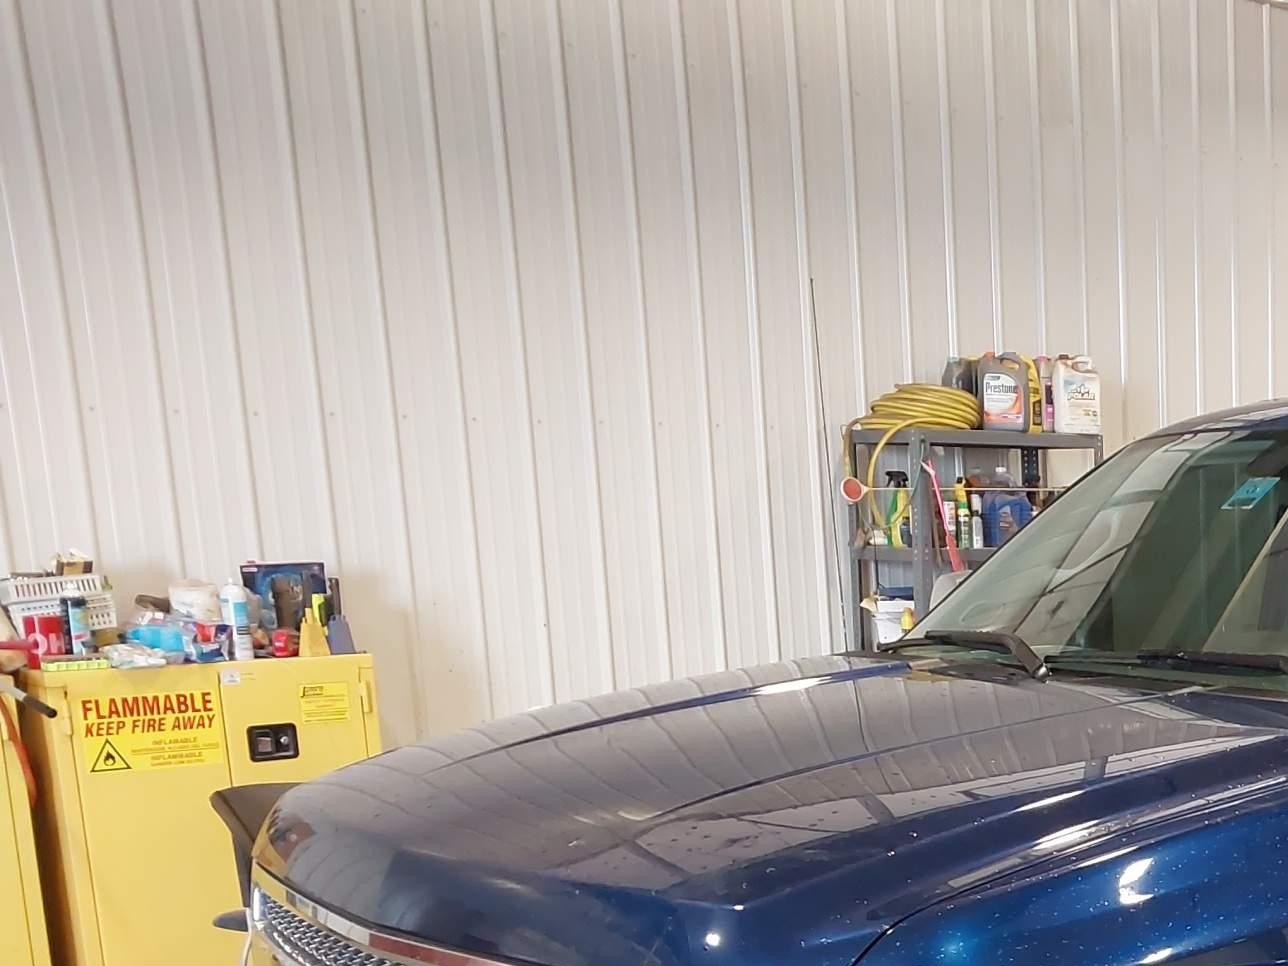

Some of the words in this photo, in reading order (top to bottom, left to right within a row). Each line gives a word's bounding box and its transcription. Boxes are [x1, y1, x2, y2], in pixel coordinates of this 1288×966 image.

[985, 382, 1018, 394] Prestone
[81, 692, 213, 721] FLAMMABLE
[84, 720, 126, 738] KEEP
[131, 717, 166, 734] FIRE
[171, 714, 216, 731] AWAY
